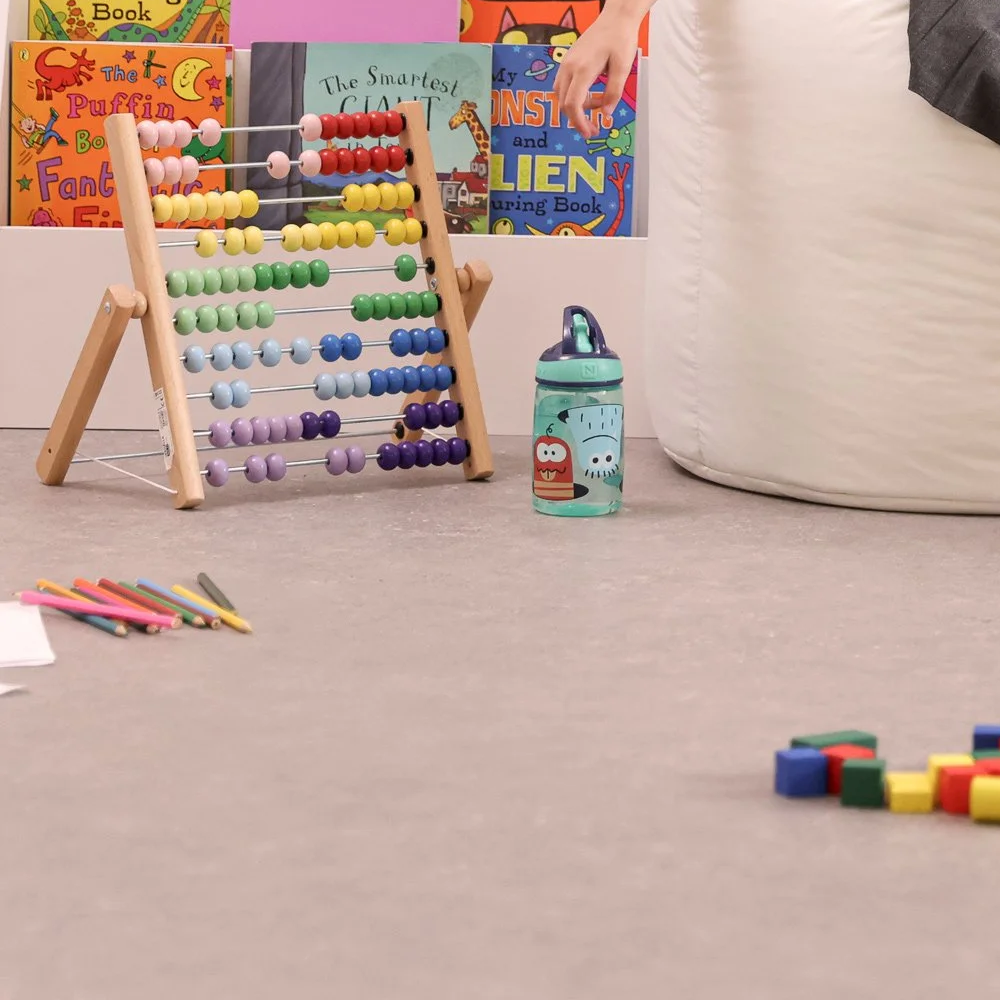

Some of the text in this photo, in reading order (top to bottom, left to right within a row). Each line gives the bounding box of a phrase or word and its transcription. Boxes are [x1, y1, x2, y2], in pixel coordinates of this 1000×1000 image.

[92, 3, 152, 22] Book
[100, 65, 138, 83] The
[318, 64, 461, 98] The Smartest
[66, 92, 175, 120] Puffin
[512, 131, 548, 148] and
[553, 196, 603, 214] Book
